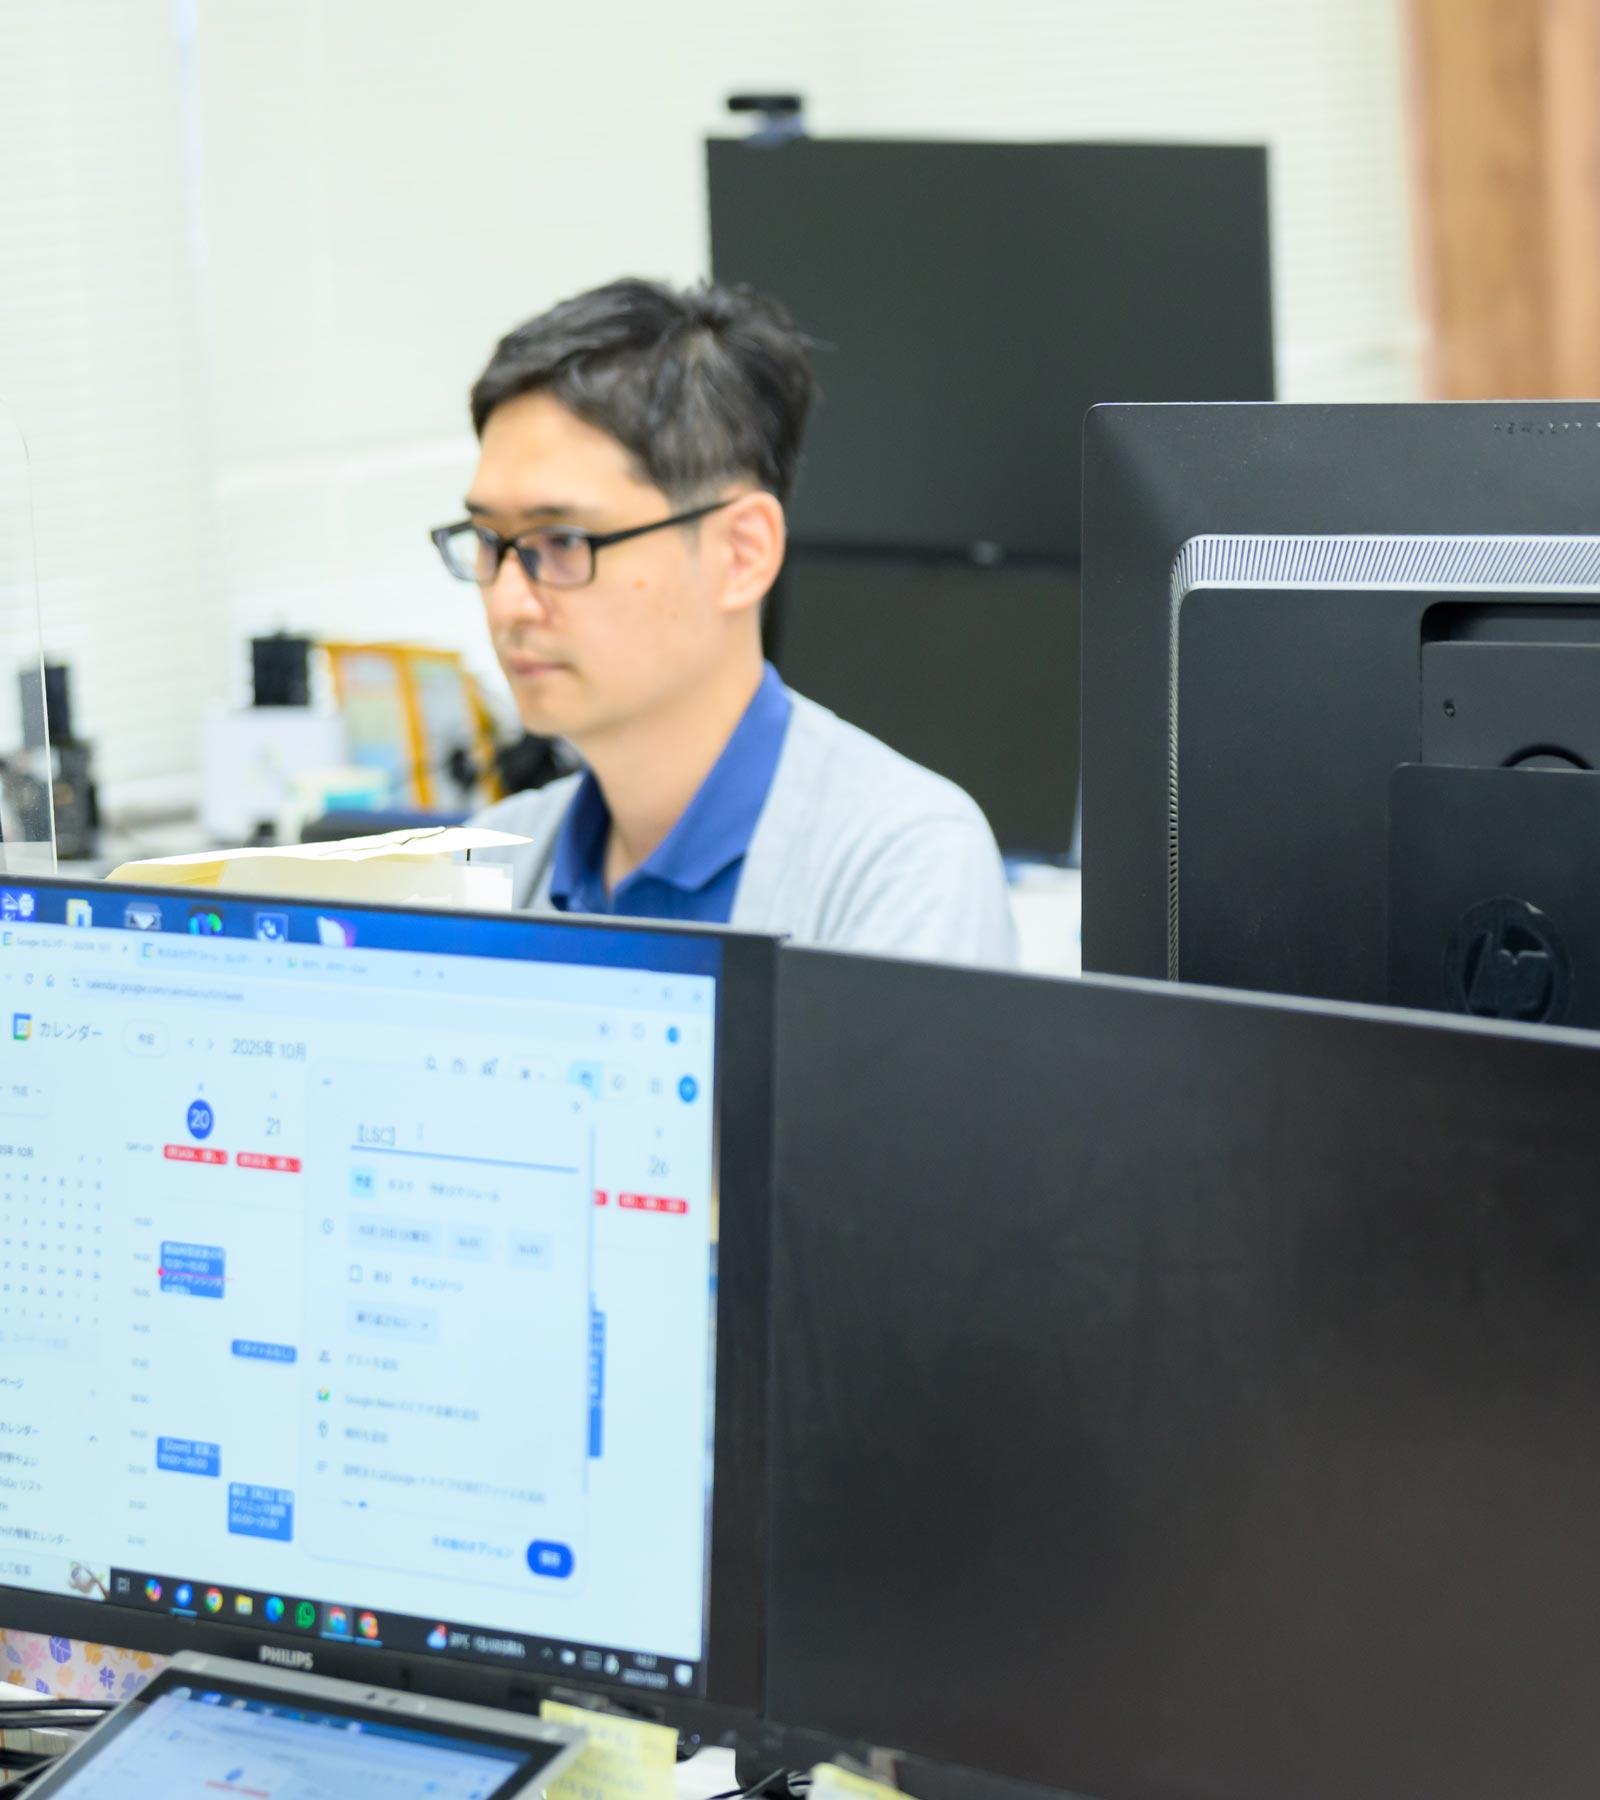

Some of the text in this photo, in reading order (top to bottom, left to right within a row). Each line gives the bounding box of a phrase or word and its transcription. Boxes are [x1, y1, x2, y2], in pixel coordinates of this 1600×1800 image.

[40, 1022, 103, 1041] カレンダー
[233, 1039, 307, 1061] 2025年 10月
[190, 1110, 210, 1129] 20
[266, 1118, 281, 1135] 21
[260, 1645, 314, 1670] PHILIPS
